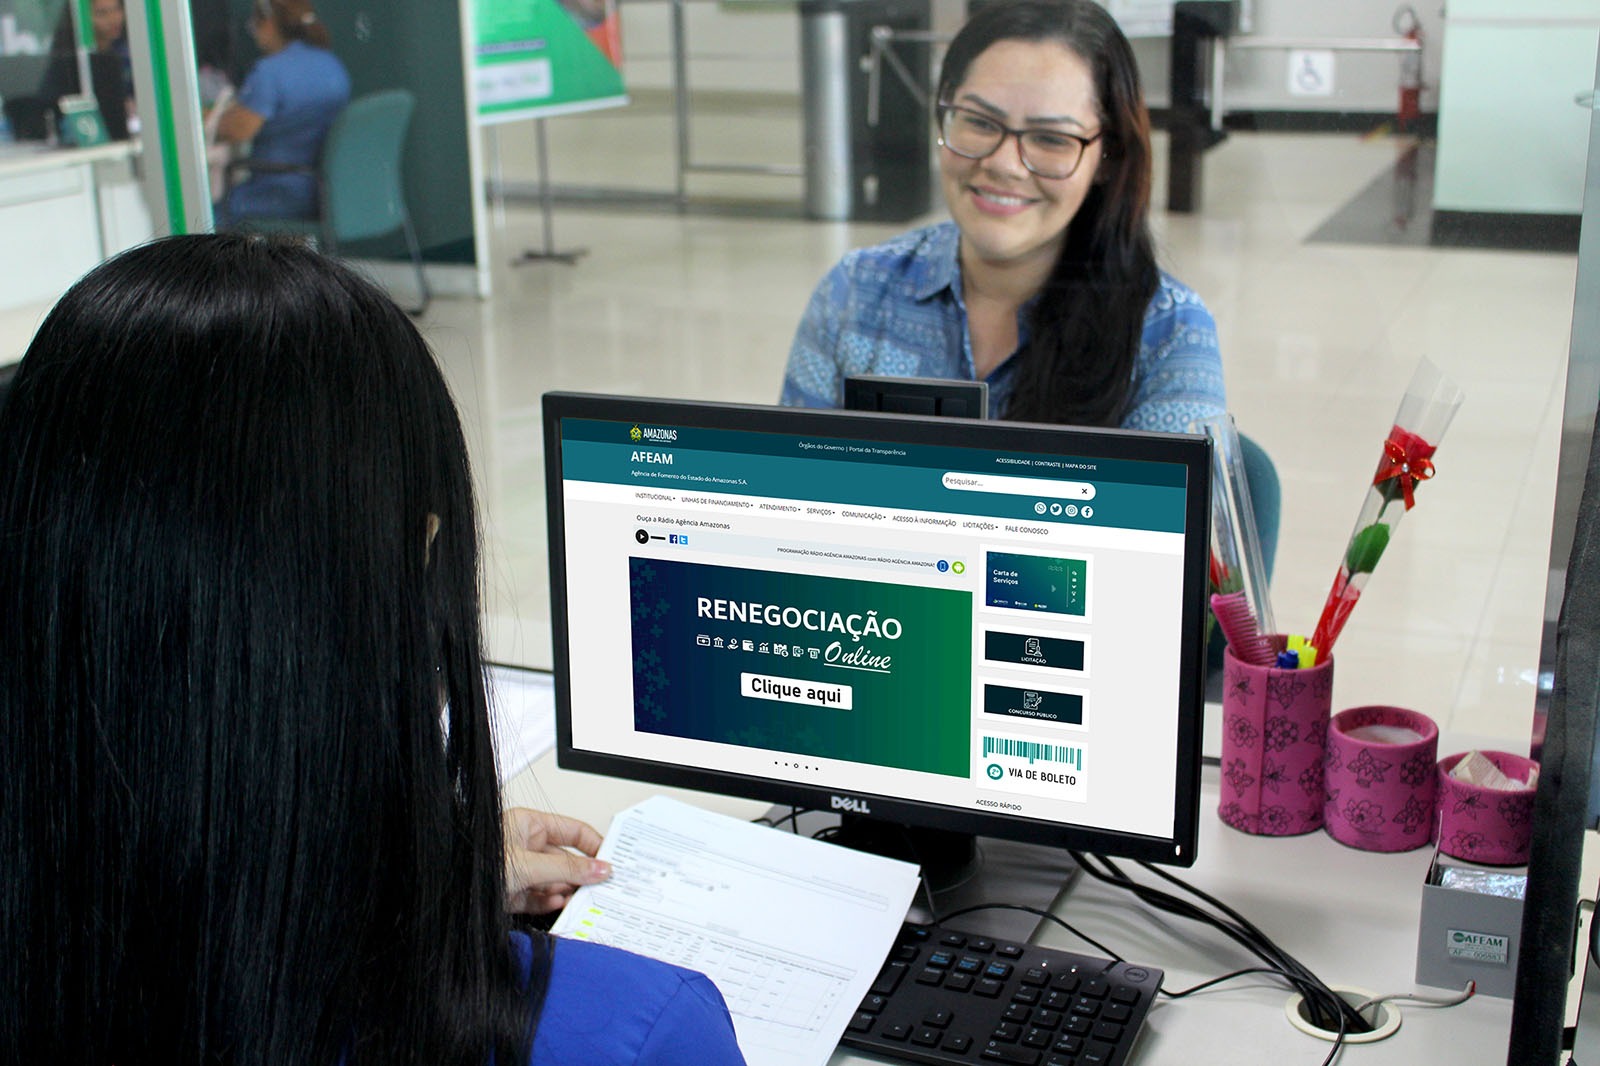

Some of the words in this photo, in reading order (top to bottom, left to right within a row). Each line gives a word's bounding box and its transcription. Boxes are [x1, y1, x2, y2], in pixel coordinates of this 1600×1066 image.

[643, 428, 678, 440] AMAZONAS
[798, 442, 816, 450] Órgãos
[872, 448, 906, 456] Transparência
[630, 450, 673, 465] AFEAM
[996, 458, 1030, 466] ACESSIBILIDADE
[635, 492, 672, 501] INSTITUCIONAL
[708, 499, 750, 508] FINANCIAMENTO
[759, 504, 797, 512] ATENDIMENTO
[806, 508, 832, 516] SERVIÇOS
[842, 510, 883, 520] COMUNICAÇÃO
[920, 518, 956, 527] INFORMAÇÃO
[963, 522, 994, 531] LICITAÇÕES
[1019, 527, 1049, 535] CONOSCO
[636, 515, 652, 523] Ouça
[676, 519, 698, 527] Agência
[700, 521, 730, 529] Amazonas
[993, 577, 1018, 585] Serviços
[697, 597, 902, 642] RENEGOCIAÇÃO
[824, 641, 891, 669] Online
[751, 678, 802, 698] Clique
[807, 687, 841, 704] aqui
[1008, 708, 1036, 717] CONCURSO
[1037, 711, 1057, 719] PÚBLICO
[1008, 768, 1023, 778] VIA
[1026, 770, 1037, 780] DE
[1041, 772, 1076, 785] BOLETO
[831, 796, 870, 814] DELL
[976, 799, 998, 808] ACESSO
[1000, 801, 1022, 811] RÁPIDO
[1465, 935, 1502, 947] AFEAM
